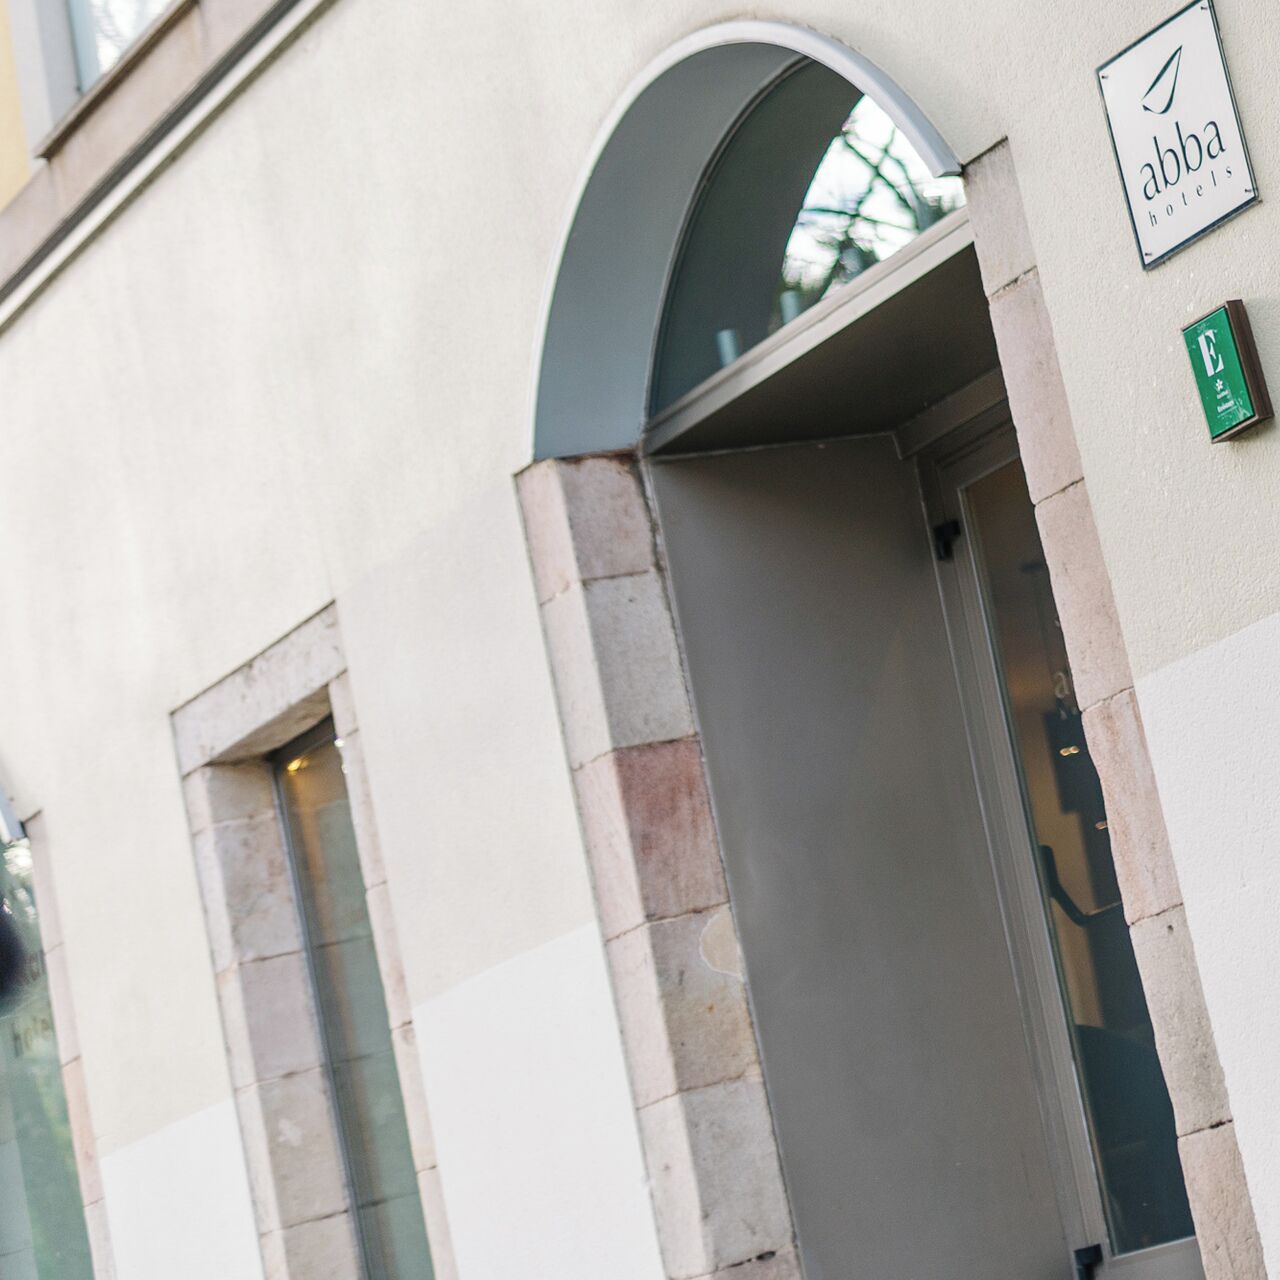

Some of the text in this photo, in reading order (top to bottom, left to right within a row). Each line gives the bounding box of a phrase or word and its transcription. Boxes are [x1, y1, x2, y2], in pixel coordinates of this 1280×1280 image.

[1140, 121, 1226, 201] abba
[1148, 164, 1232, 227] hotels
[1198, 329, 1224, 378] E
